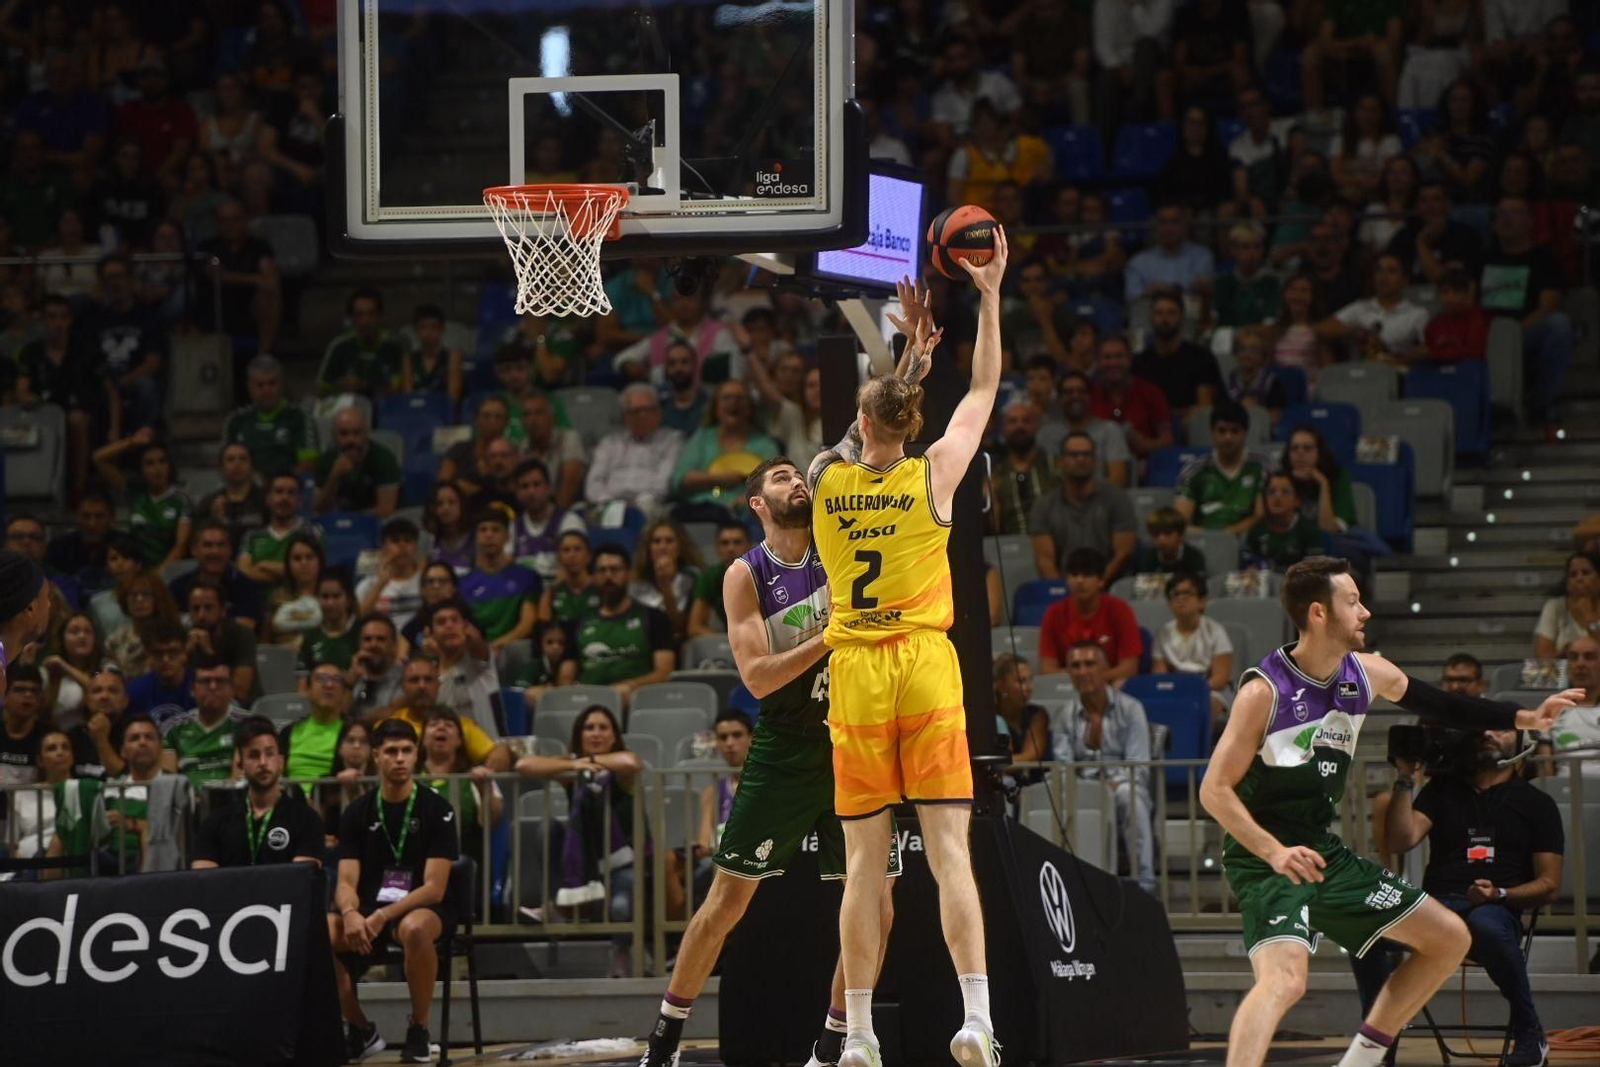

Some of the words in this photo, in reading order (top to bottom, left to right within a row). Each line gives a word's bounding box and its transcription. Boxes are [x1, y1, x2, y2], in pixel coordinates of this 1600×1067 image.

[756, 170, 780, 184] liga
[756, 182, 808, 195] endesa
[885, 228, 911, 252] Banco
[825, 493, 915, 515] BALCEROWSKI
[851, 550, 882, 609] 2
[1315, 727, 1351, 744] Unicaja
[2, 894, 292, 987] desa
